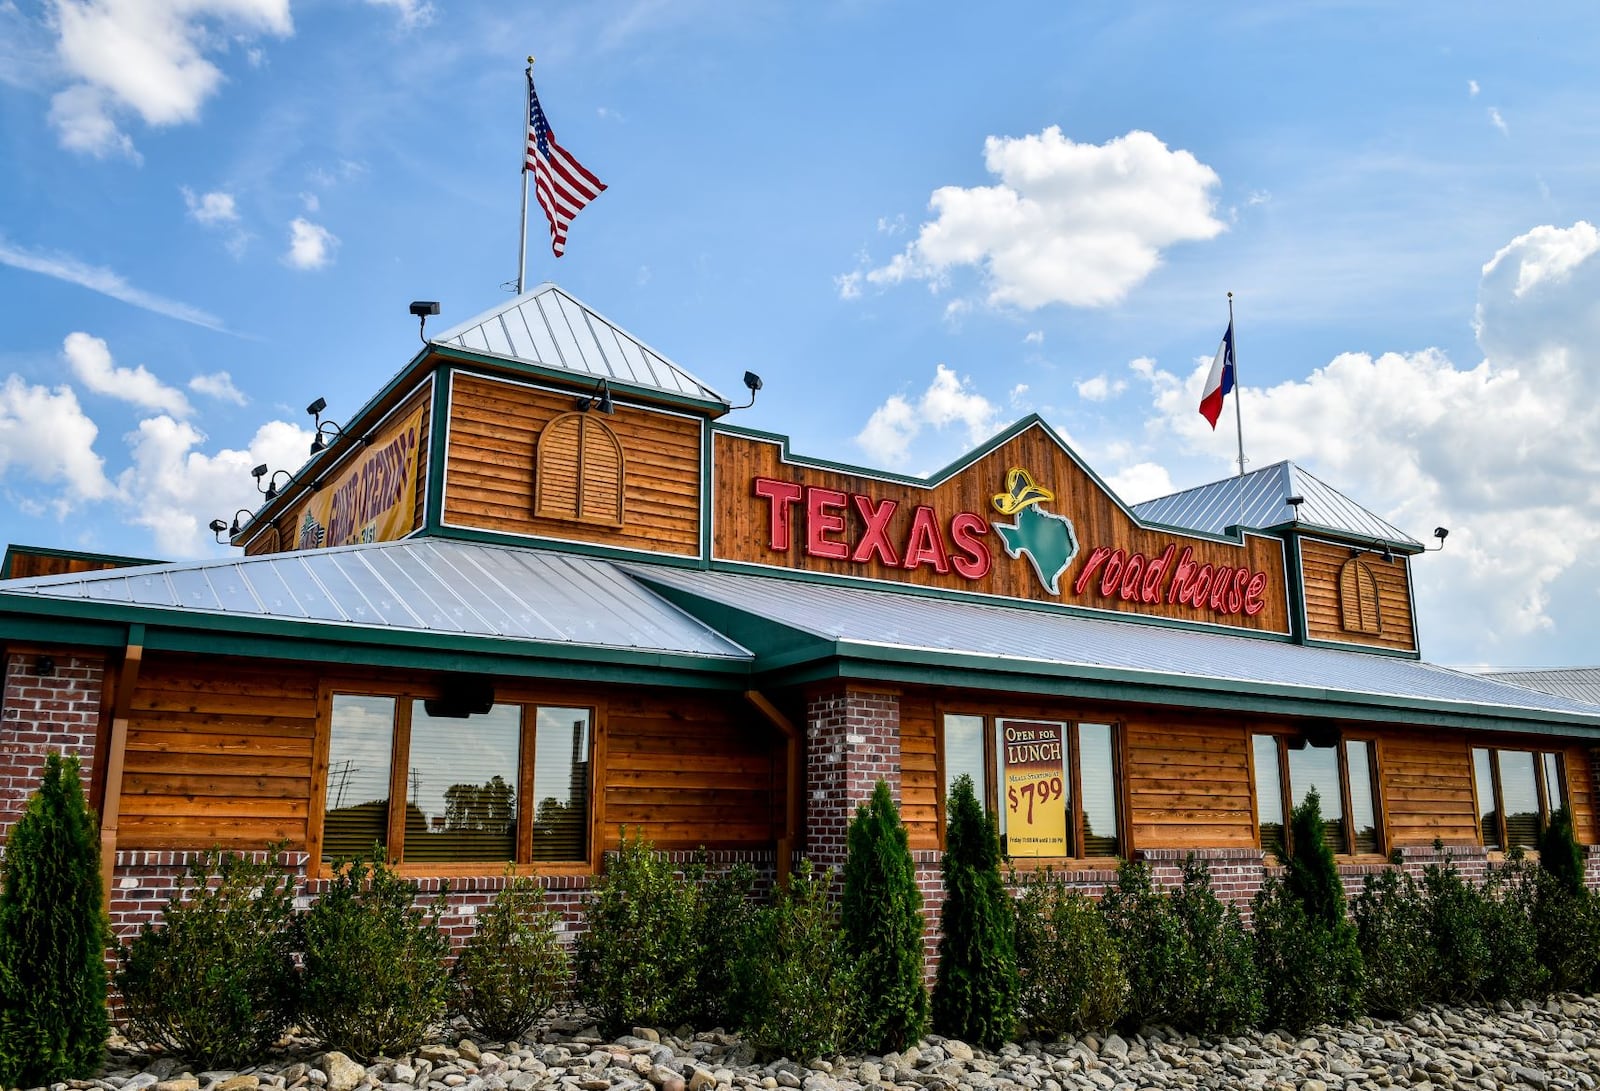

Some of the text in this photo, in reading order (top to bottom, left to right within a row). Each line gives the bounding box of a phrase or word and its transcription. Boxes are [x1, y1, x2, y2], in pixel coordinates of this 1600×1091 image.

[754, 477, 992, 582] TEXAS
[1005, 727, 1056, 742] OPEN FOR
[1008, 743, 1061, 764] LUNCH
